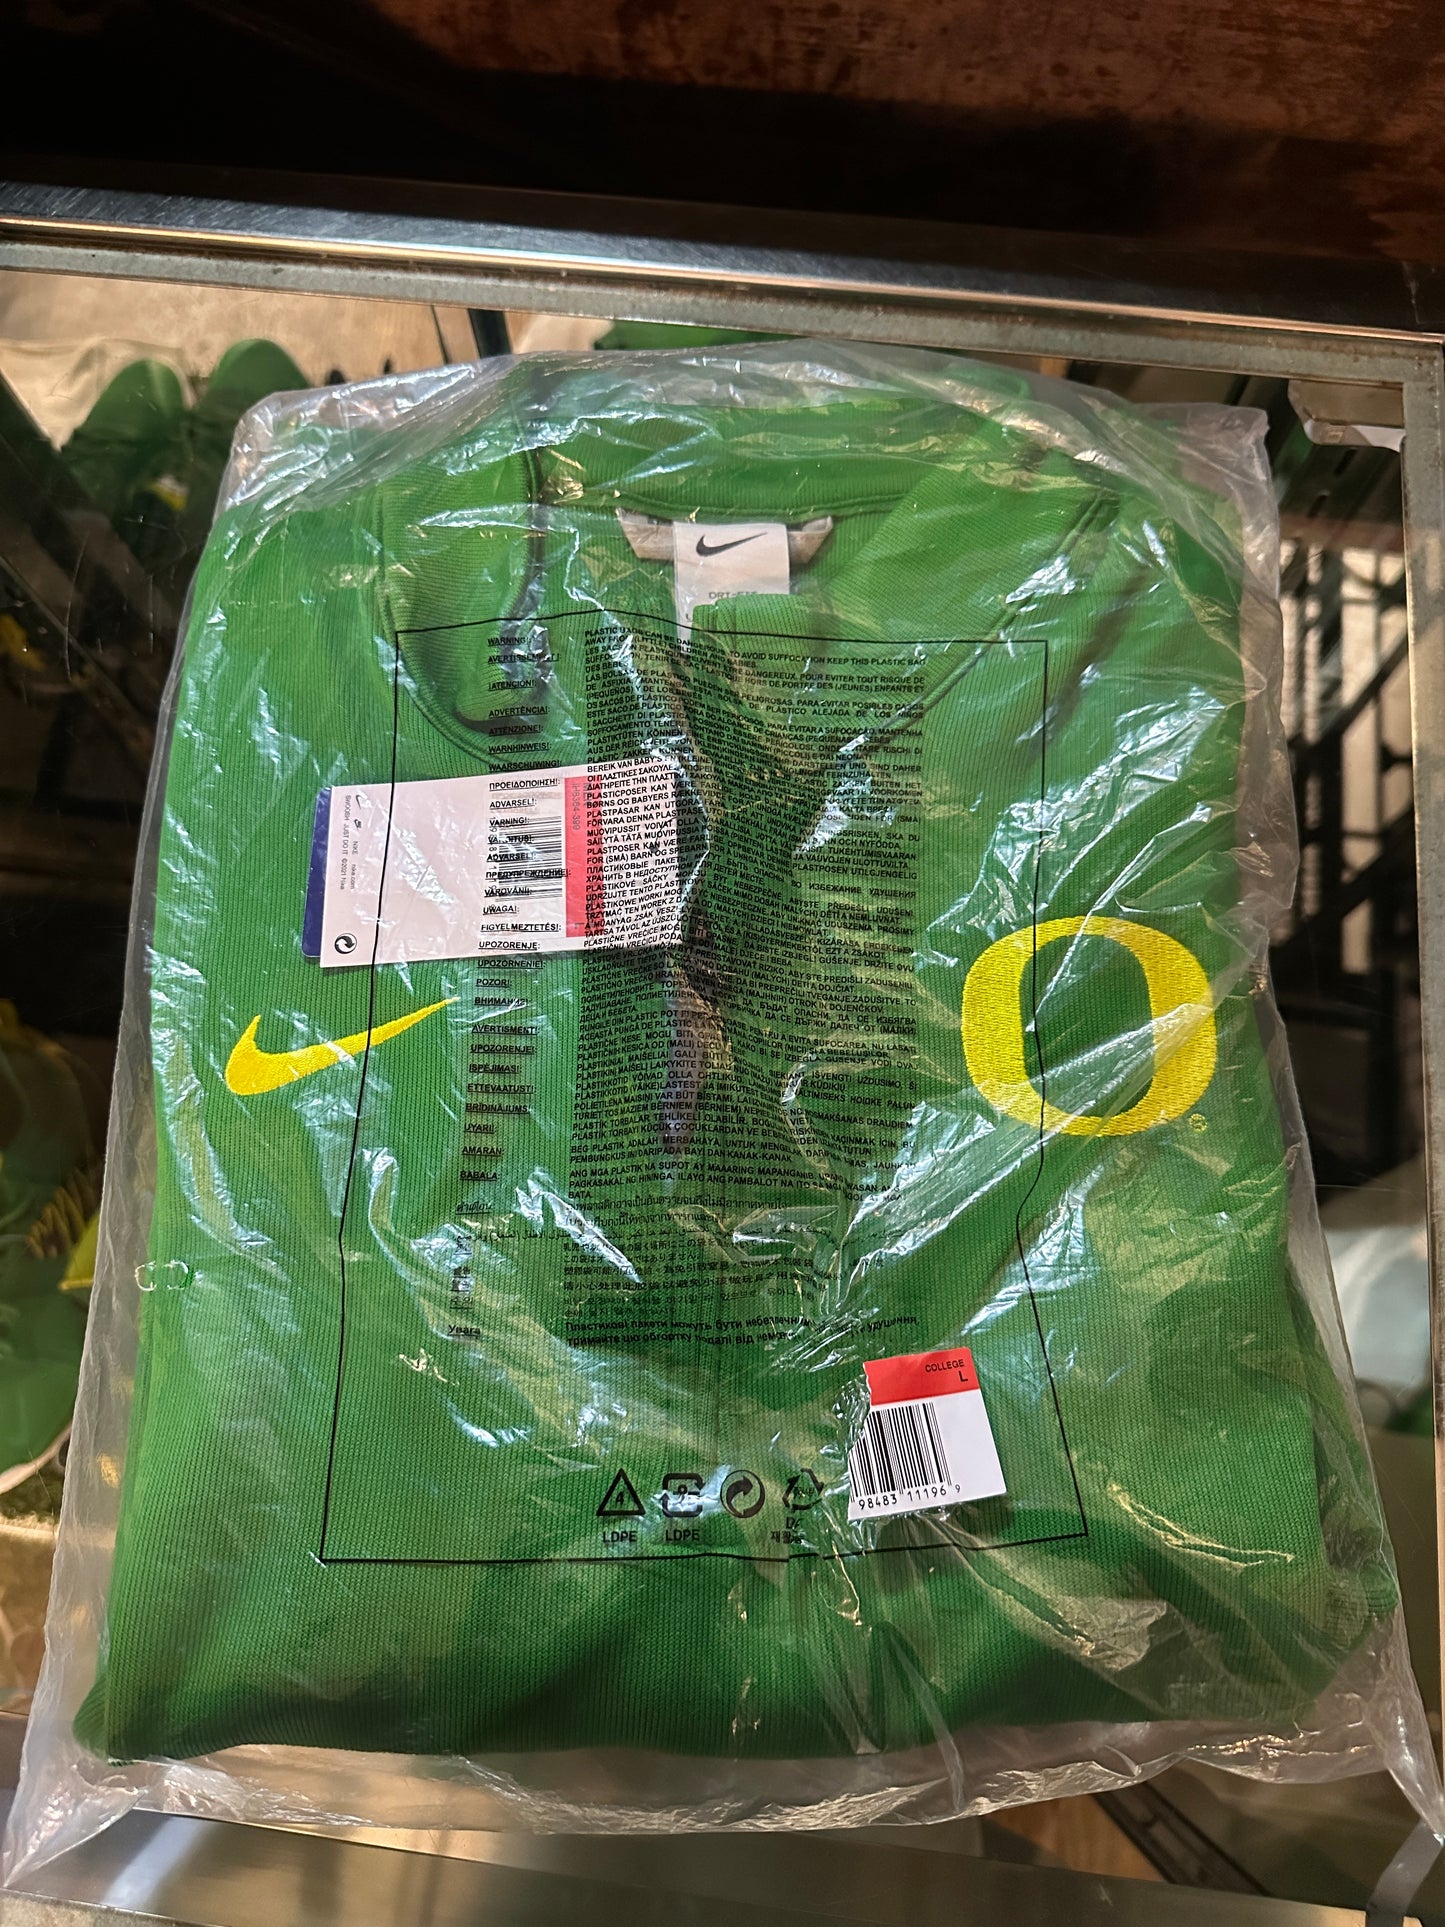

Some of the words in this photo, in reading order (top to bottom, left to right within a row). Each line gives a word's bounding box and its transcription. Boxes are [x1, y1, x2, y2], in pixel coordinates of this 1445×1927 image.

[742, 652, 766, 660] AVOID
[827, 657, 849, 665] KEEP
[587, 761, 616, 772] BEREIK
[617, 760, 633, 769] VAN
[635, 776, 647, 784] ΤΗΝ
[587, 786, 647, 800] PLASTICPOSER
[651, 783, 667, 792] KAN
[587, 799, 615, 809] BØRNS
[631, 792, 669, 804] BABYERS
[644, 803, 660, 812] KAN
[626, 813, 654, 825] DENNA
[587, 824, 640, 837] MUOVIPUSSIT
[587, 843, 640, 855] PLASTPOSER
[630, 850, 652, 859] BARN
[654, 849, 667, 857] OG
[587, 861, 648, 874] ПЛАСТИКОВЫЕ
[629, 885, 653, 896] TENTO
[585, 898, 636, 911] PLASTIKOWE
[639, 892, 662, 903] WORKI
[624, 906, 639, 914] TEN
[641, 899, 667, 911] WOREK
[659, 1161, 690, 1170] SUPOT
[924, 1359, 965, 1373] COLLEGE
[958, 1371, 968, 1383] L
[858, 1493, 898, 1510] 98483
[907, 1485, 947, 1502] 11196
[955, 1484, 961, 1493] 9
[602, 1530, 637, 1542] LDPE
[665, 1529, 700, 1542] LDPE
